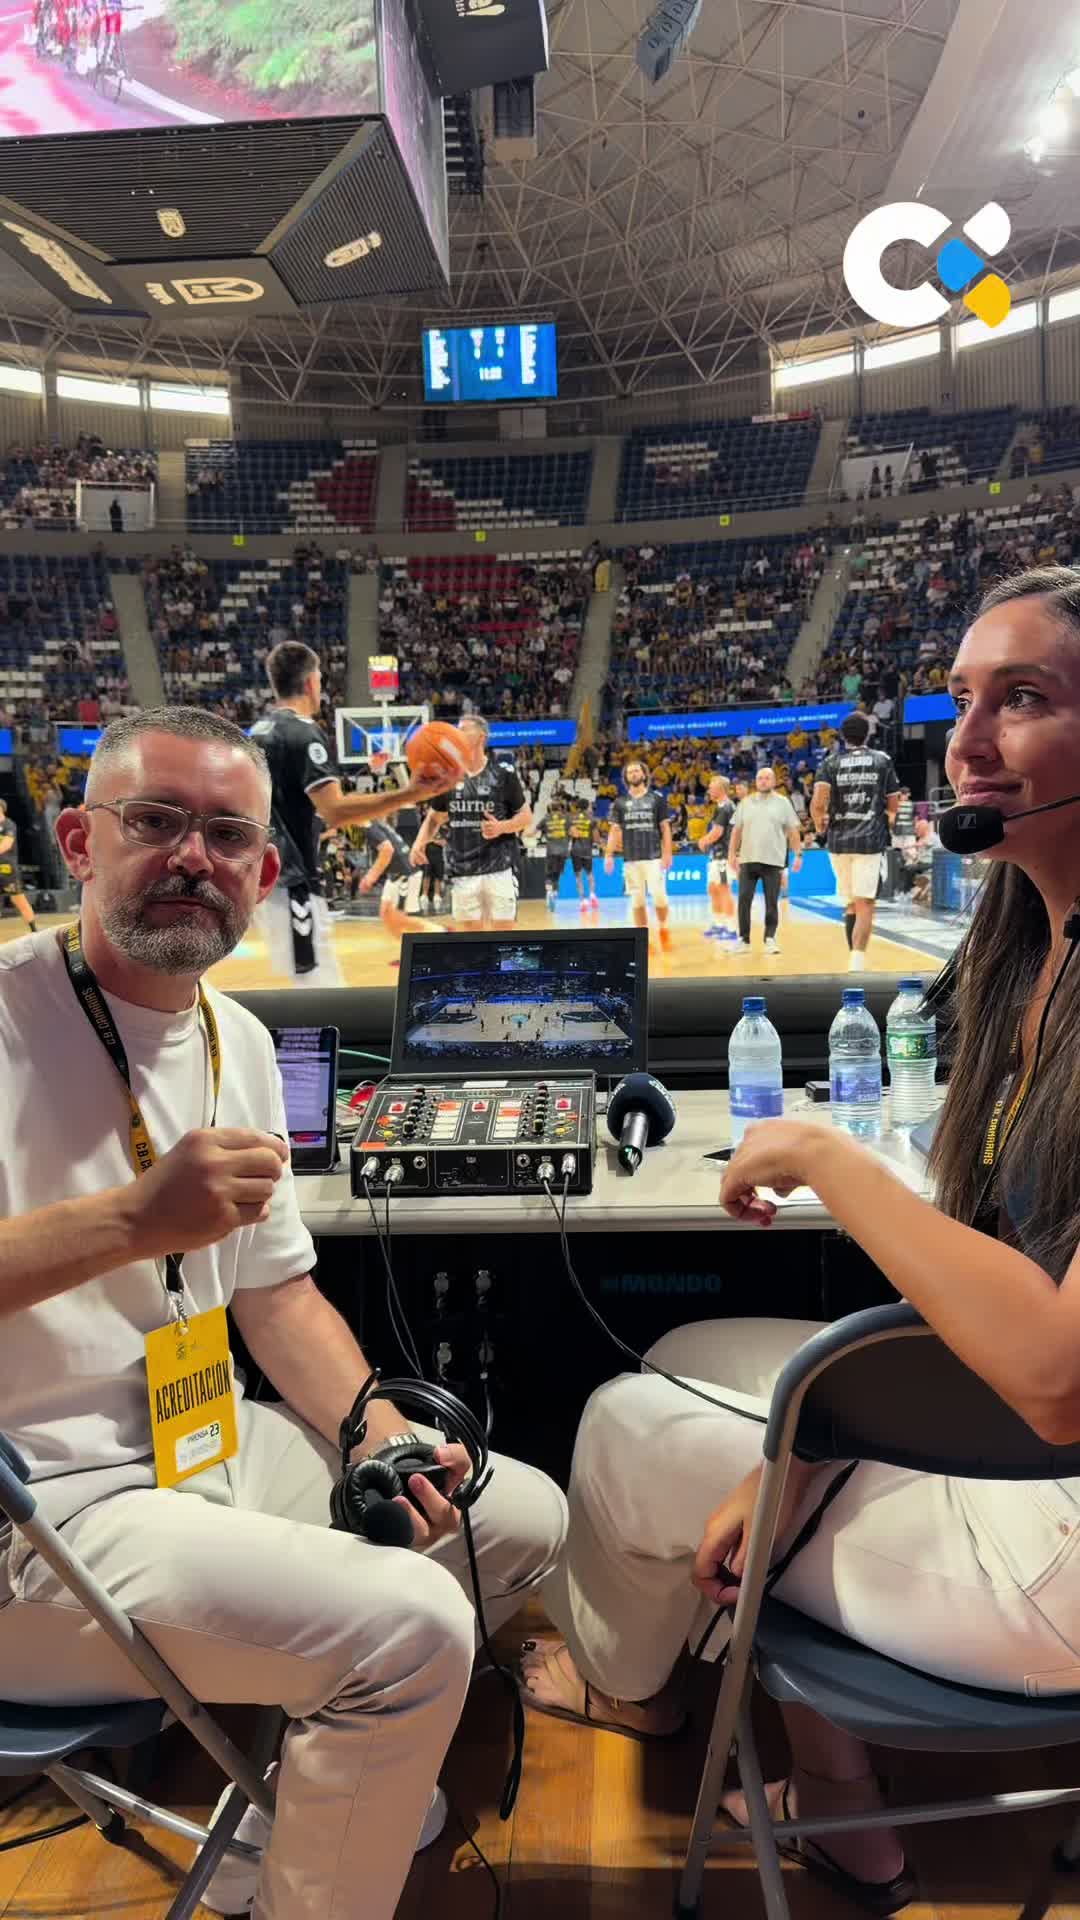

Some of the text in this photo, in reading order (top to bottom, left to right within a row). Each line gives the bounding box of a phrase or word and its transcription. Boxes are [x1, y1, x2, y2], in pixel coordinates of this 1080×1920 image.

[622, 1273, 721, 1293] MONDO
[155, 1359, 231, 1424] ACREDITACIÓN
[208, 1423, 220, 1437] 23
